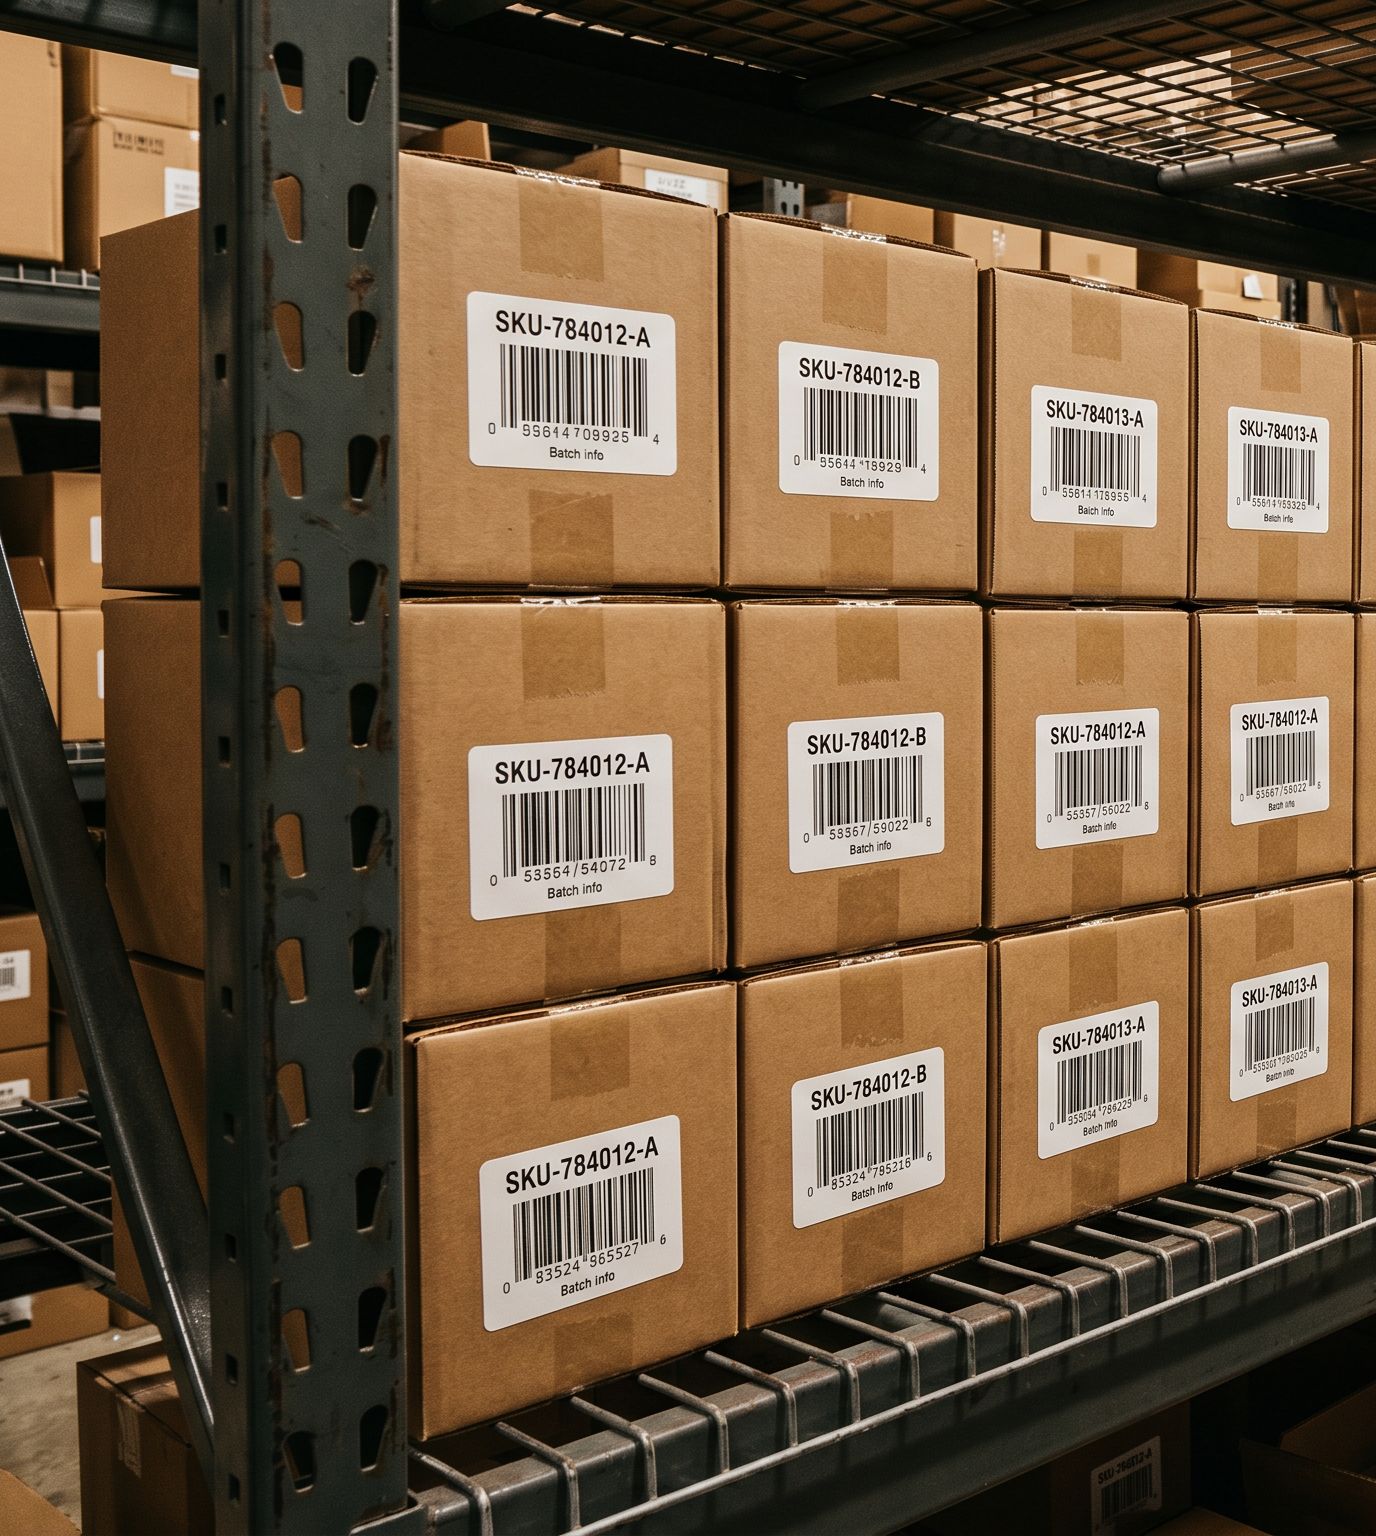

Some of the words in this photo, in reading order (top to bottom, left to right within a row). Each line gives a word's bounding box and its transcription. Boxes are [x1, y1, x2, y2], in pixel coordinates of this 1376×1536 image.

[496, 309, 651, 349] SKU-784012-A
[799, 358, 921, 390] SKU-784012-B
[1046, 399, 1144, 428] SKU-784013-A
[652, 434, 660, 445] 4
[1239, 419, 1318, 444] SKU-784013-A
[550, 446, 581, 460] Batch
[584, 449, 605, 461] info
[793, 454, 801, 466] 0
[920, 464, 927, 474] 4
[840, 476, 866, 488] Batch
[868, 478, 884, 489] info
[1050, 721, 1146, 745] SKU-784012-A
[1241, 708, 1318, 732] SKU-784012-A
[807, 726, 927, 756] SKU-784012-B
[496, 752, 651, 785] SKU-784012-A
[803, 832, 810, 844] 0
[849, 841, 875, 855] Batch
[877, 840, 892, 852] info
[490, 874, 498, 887] 0
[547, 885, 579, 900] Batch
[582, 881, 603, 895] info
[1241, 974, 1318, 1008] SKU-784013-A
[1052, 1015, 1146, 1055] SKU-784013-A
[811, 1063, 927, 1110] SKU-784012-B
[506, 1136, 659, 1195] SKU-784012-A
[807, 1186, 814, 1198] 0
[926, 1151, 932, 1162] 6
[502, 1281, 511, 1295] 0
[659, 1234, 667, 1246] 6
[560, 1277, 592, 1297] Batch
[594, 1271, 615, 1286] info
